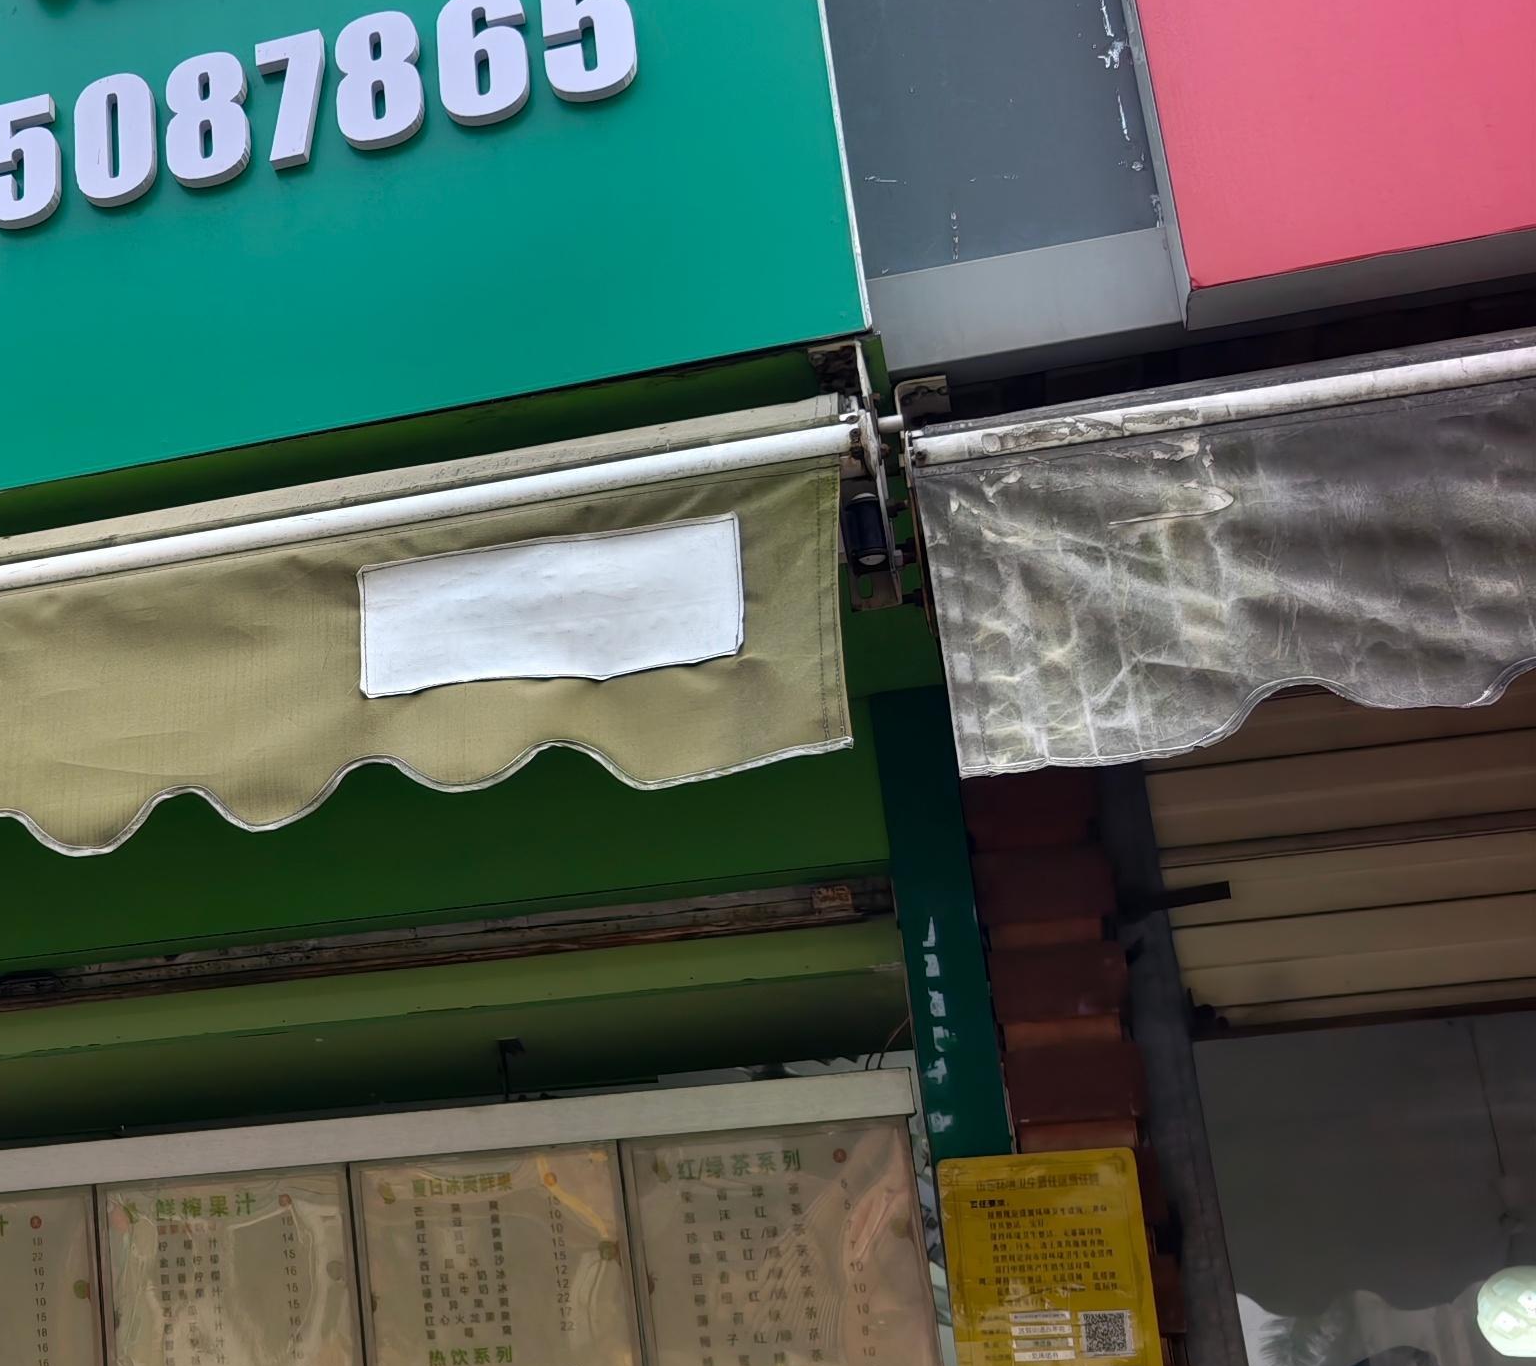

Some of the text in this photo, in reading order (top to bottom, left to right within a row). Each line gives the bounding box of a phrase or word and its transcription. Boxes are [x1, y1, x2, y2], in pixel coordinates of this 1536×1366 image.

[676, 1147, 803, 1182] 红/绿茶系列
[154, 1191, 258, 1221] 鲜榨果汁
